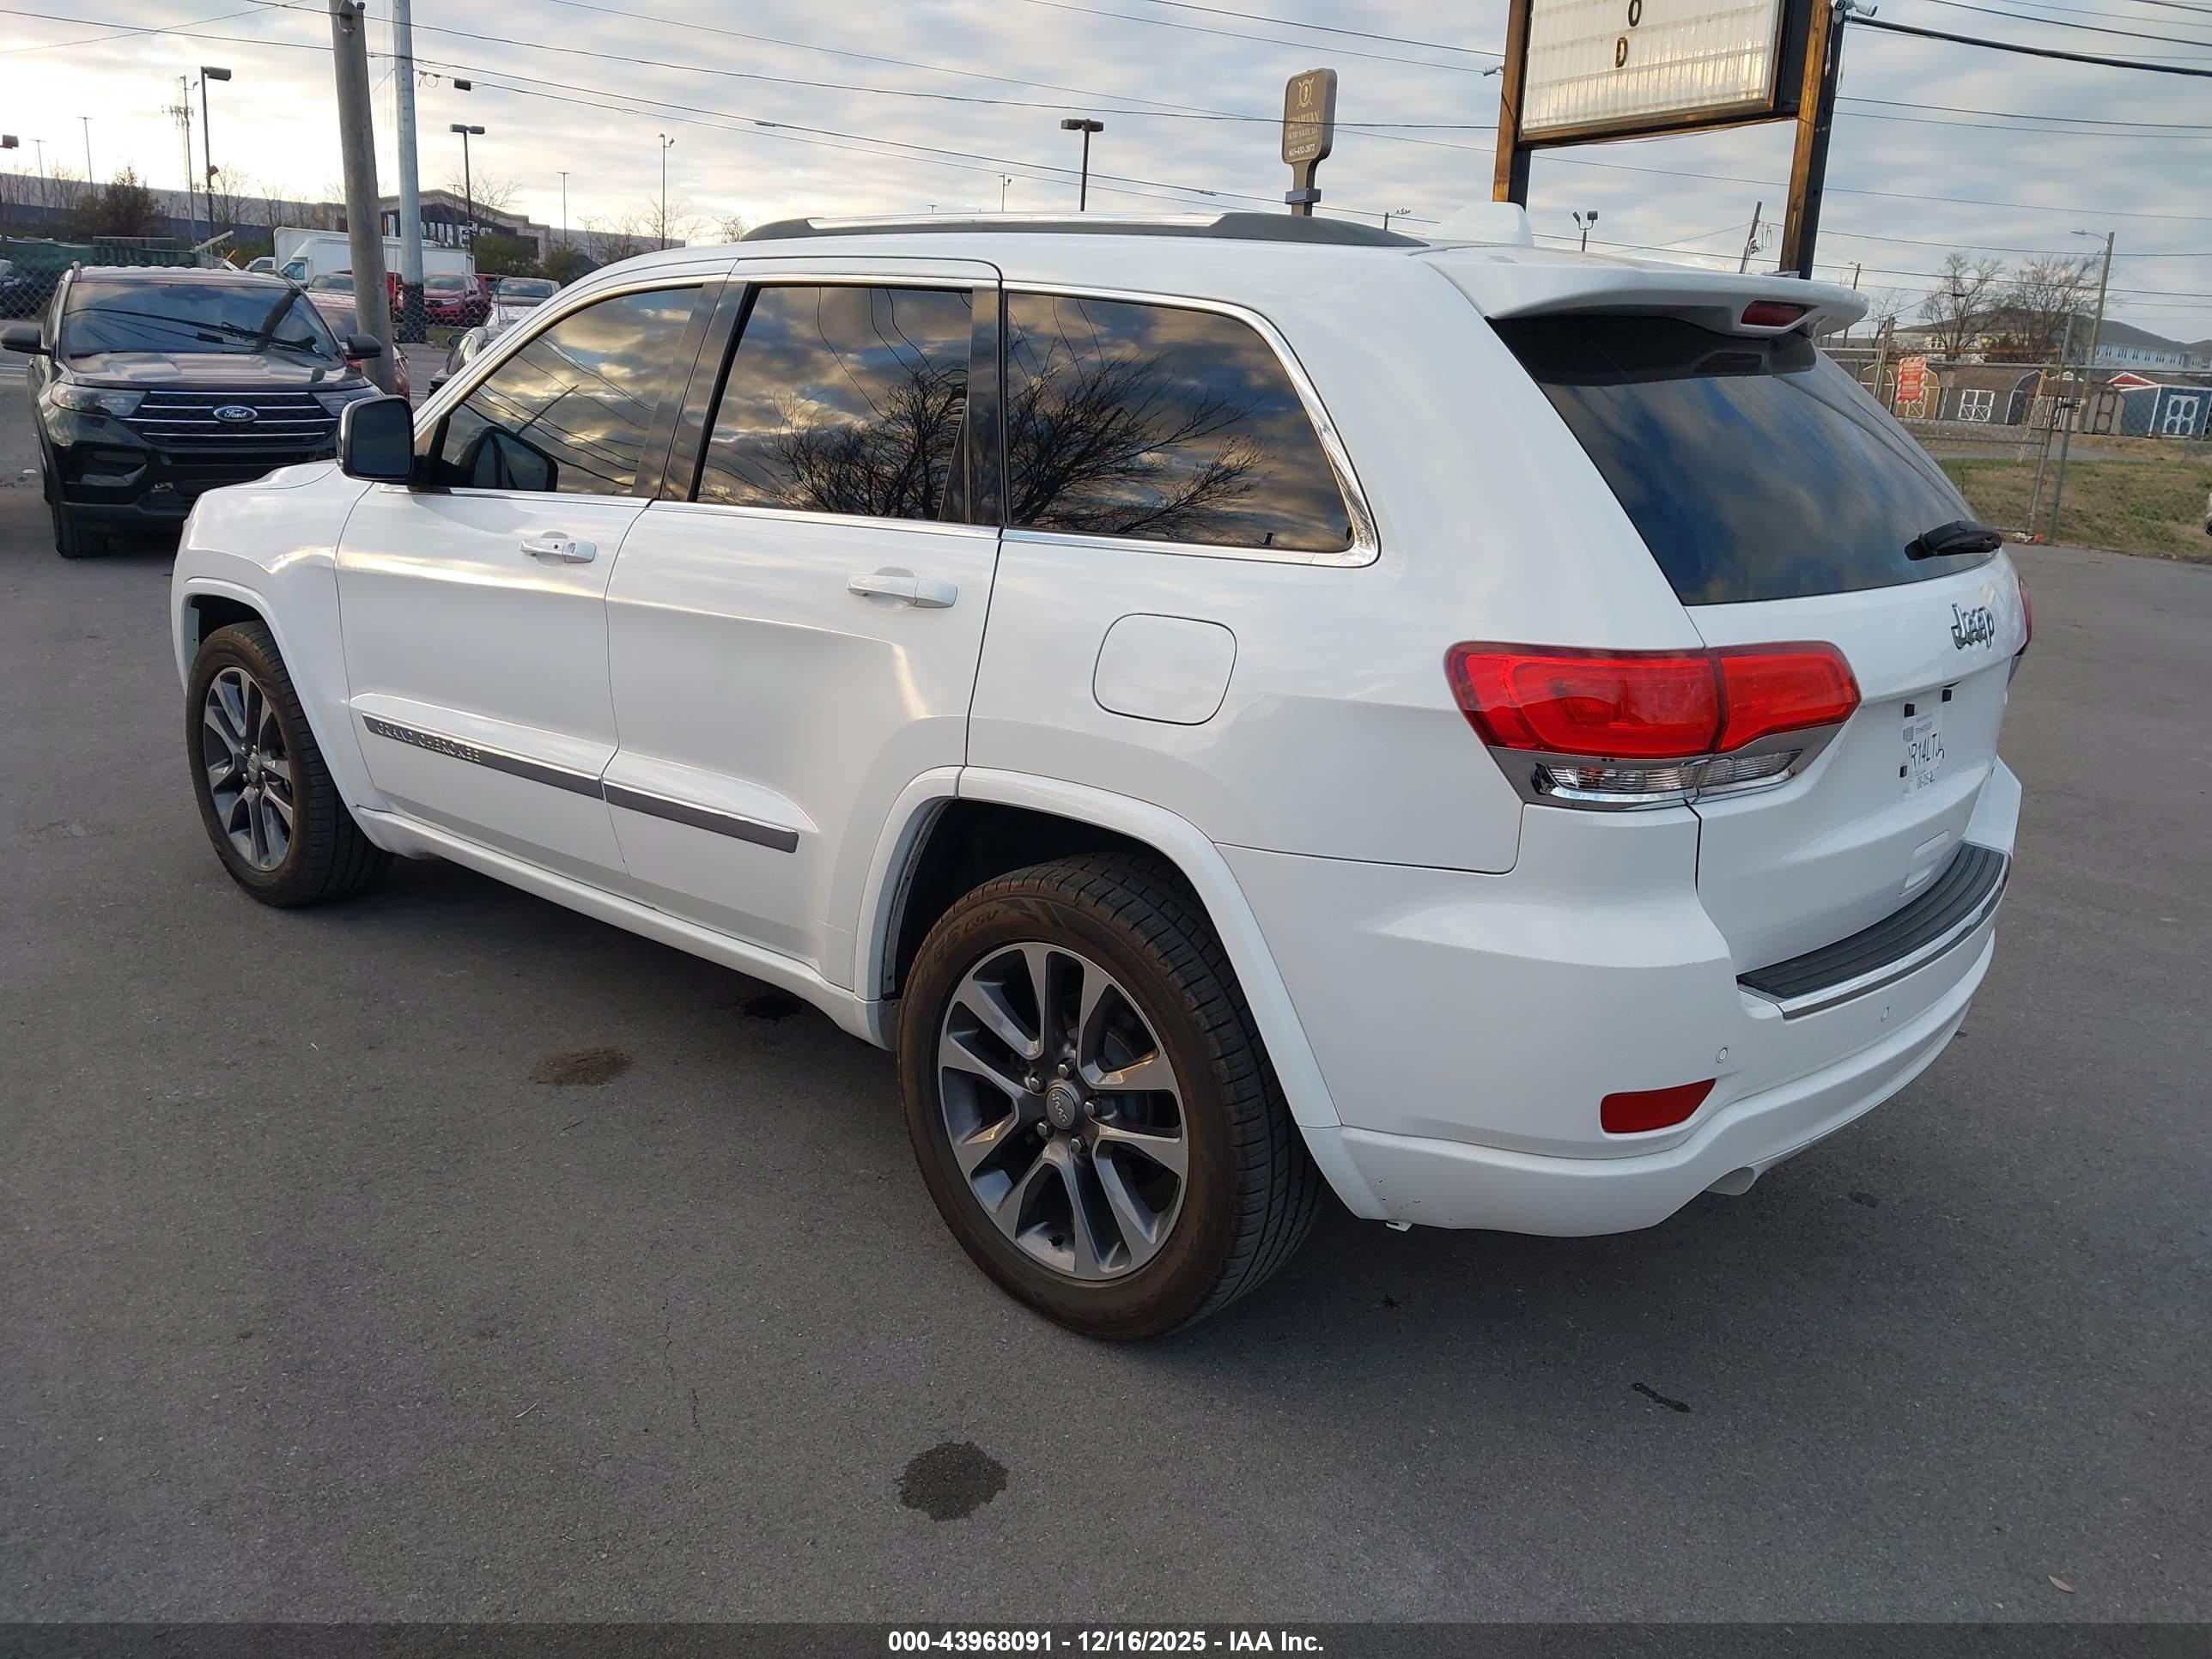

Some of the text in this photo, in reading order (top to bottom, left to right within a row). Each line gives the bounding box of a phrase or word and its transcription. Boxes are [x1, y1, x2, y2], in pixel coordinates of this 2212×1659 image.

[224, 409, 247, 418] Ford
[1949, 602, 1995, 650] Jeep
[376, 722, 481, 763] GRAND CHEROKEE
